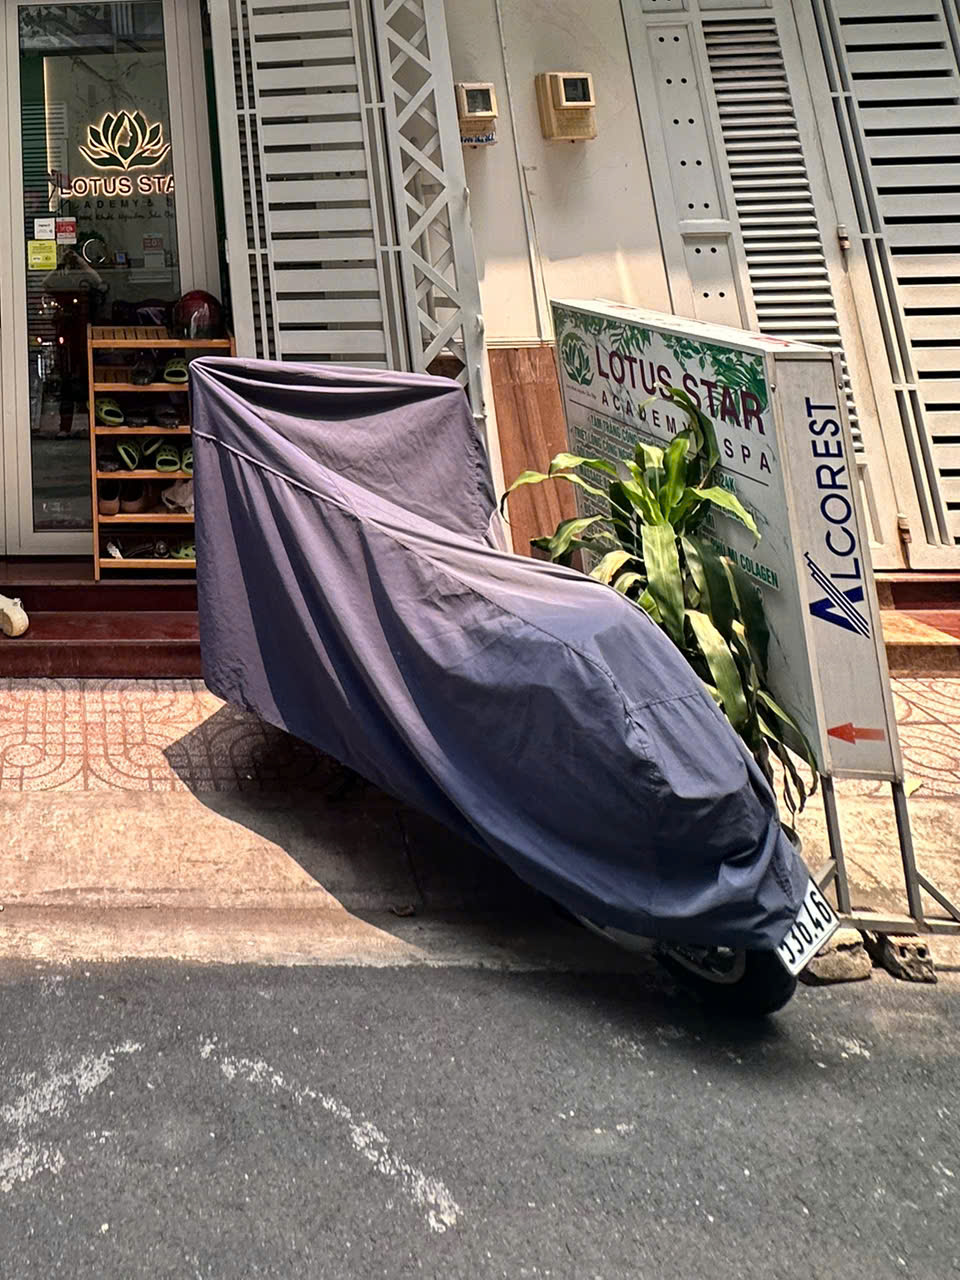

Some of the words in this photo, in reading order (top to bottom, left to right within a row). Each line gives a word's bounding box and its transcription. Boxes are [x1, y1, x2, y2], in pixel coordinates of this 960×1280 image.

[60, 176, 132, 196] LOTUS
[139, 175, 174, 194] STA
[595, 344, 675, 401] LOTUS
[682, 372, 766, 436] STAR
[724, 438, 772, 474] SPA
[804, 397, 871, 639] ALCOREST
[739, 553, 779, 589] COLAGEN
